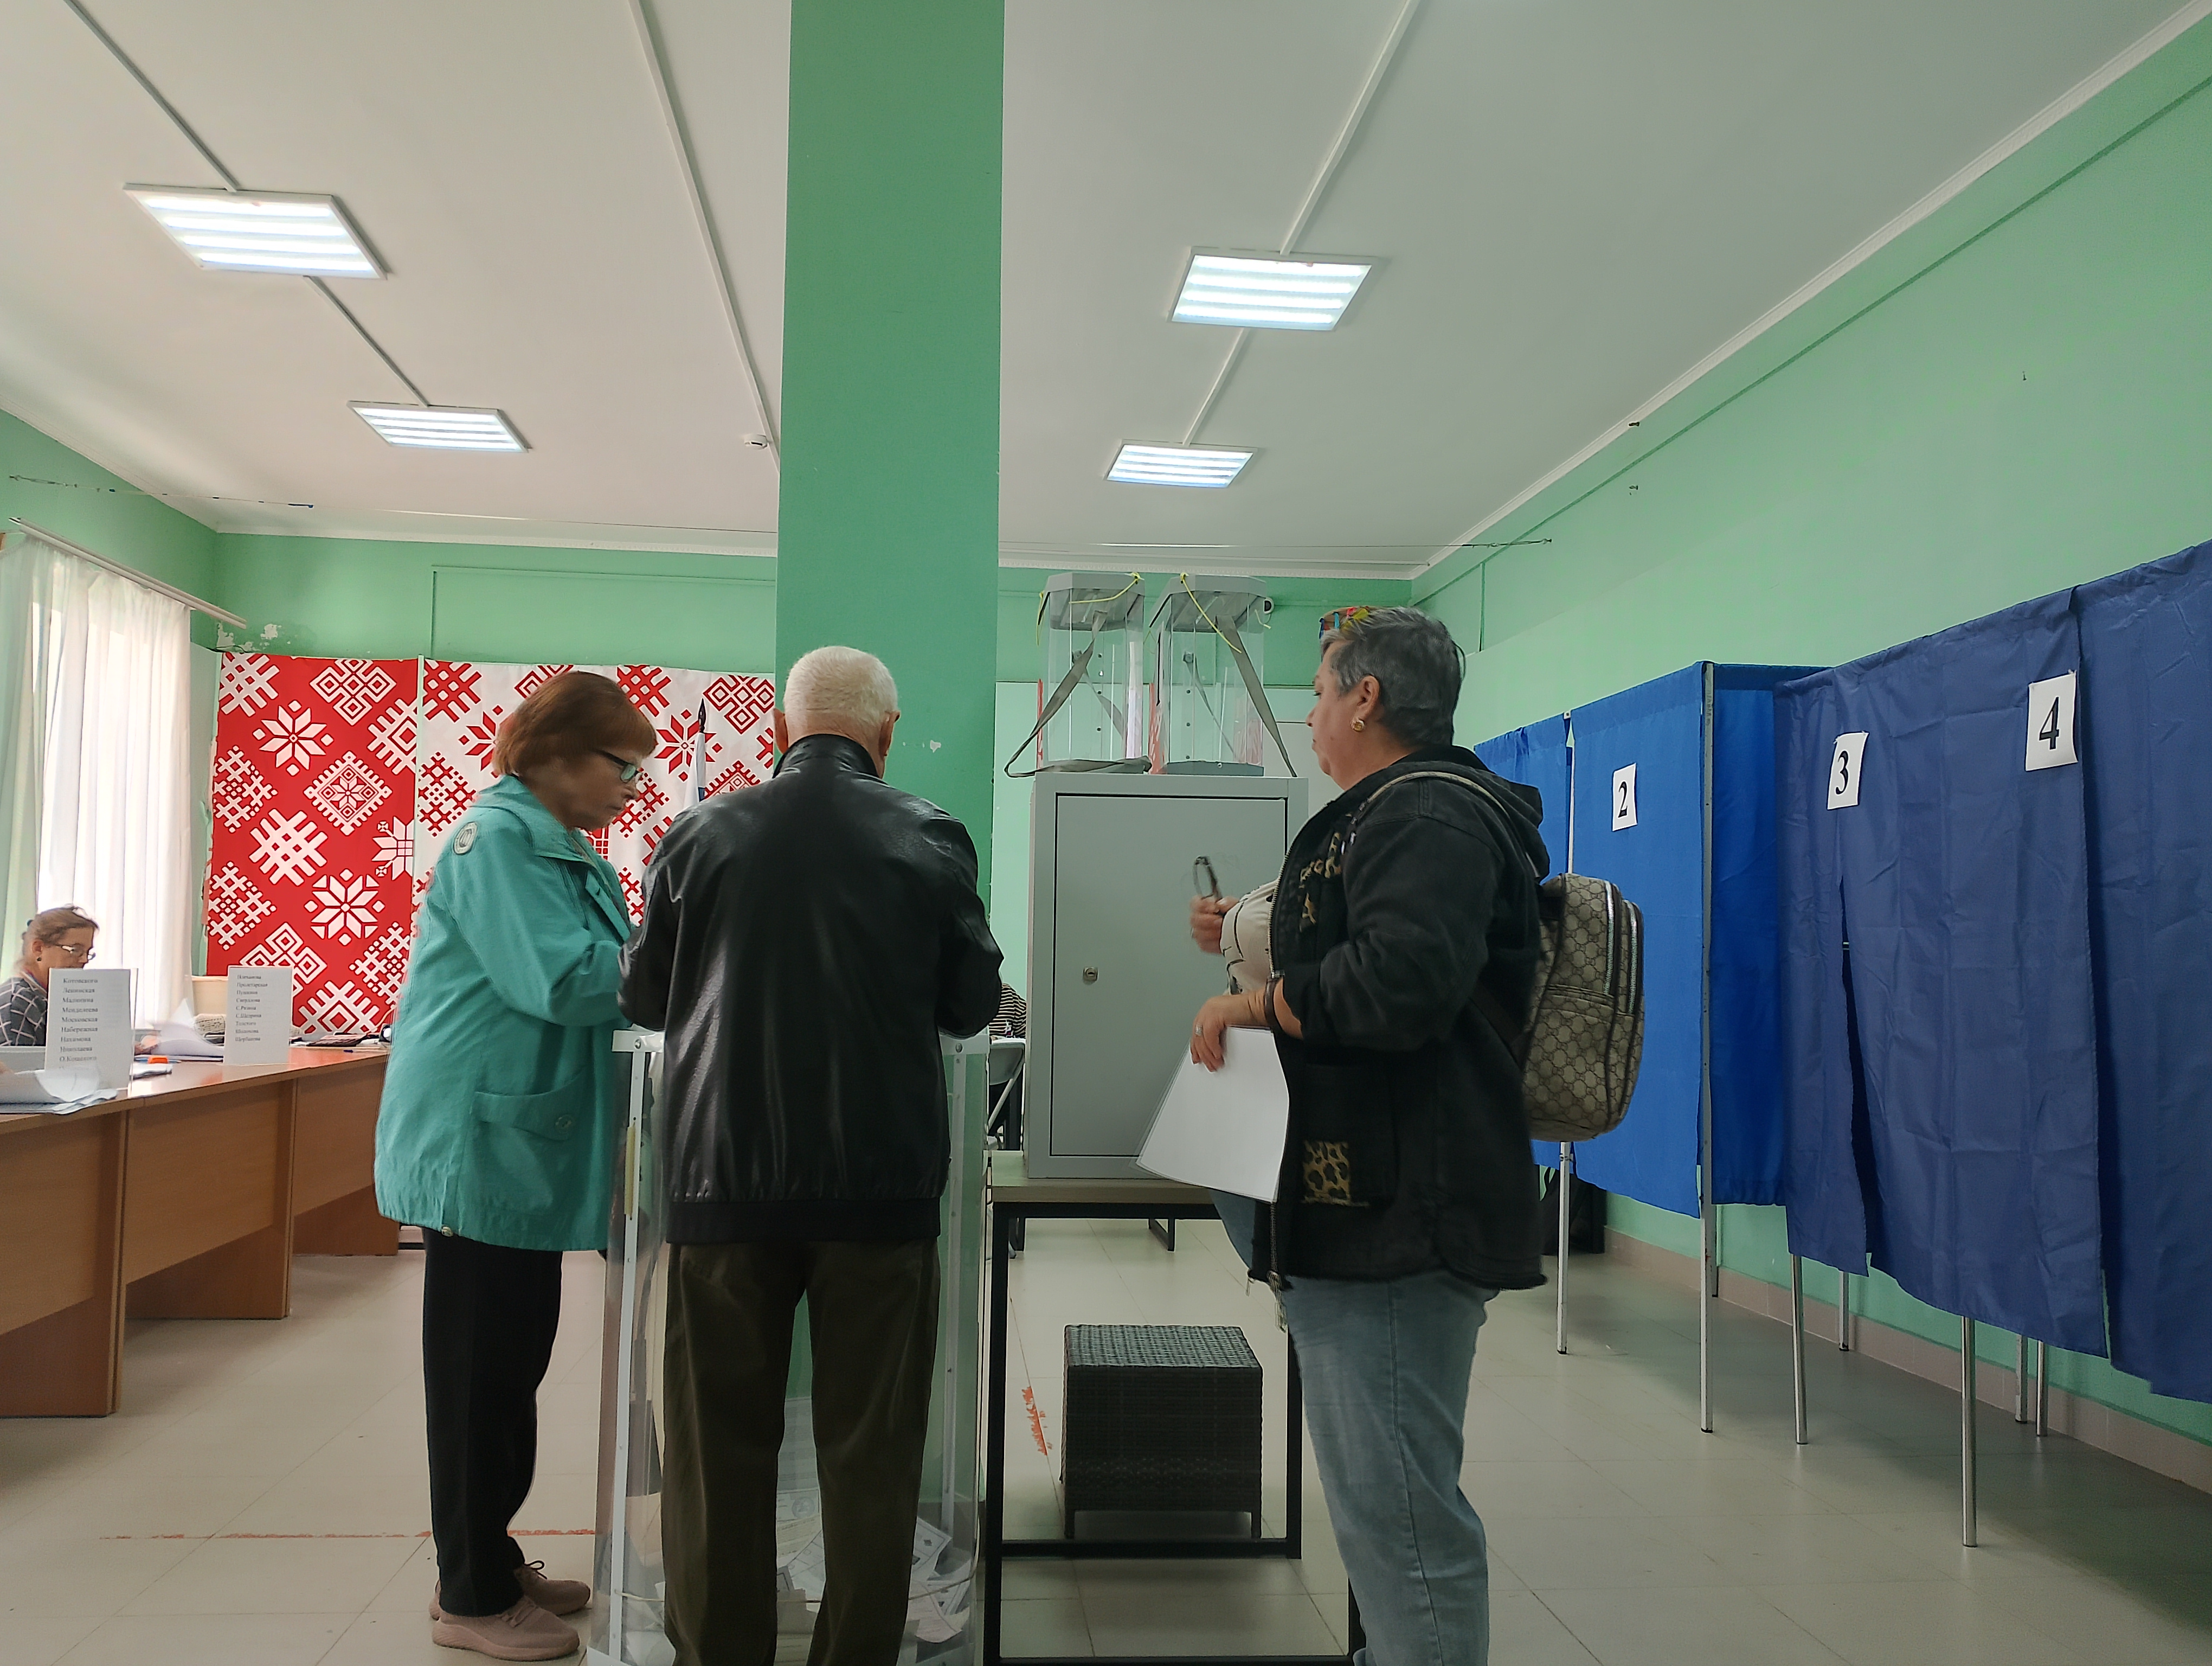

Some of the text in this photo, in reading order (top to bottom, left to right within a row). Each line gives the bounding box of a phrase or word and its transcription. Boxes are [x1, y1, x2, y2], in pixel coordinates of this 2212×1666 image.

[2039, 696, 2059, 749] 4
[1836, 751, 1849, 794] 3
[1618, 781, 1628, 818] 2
